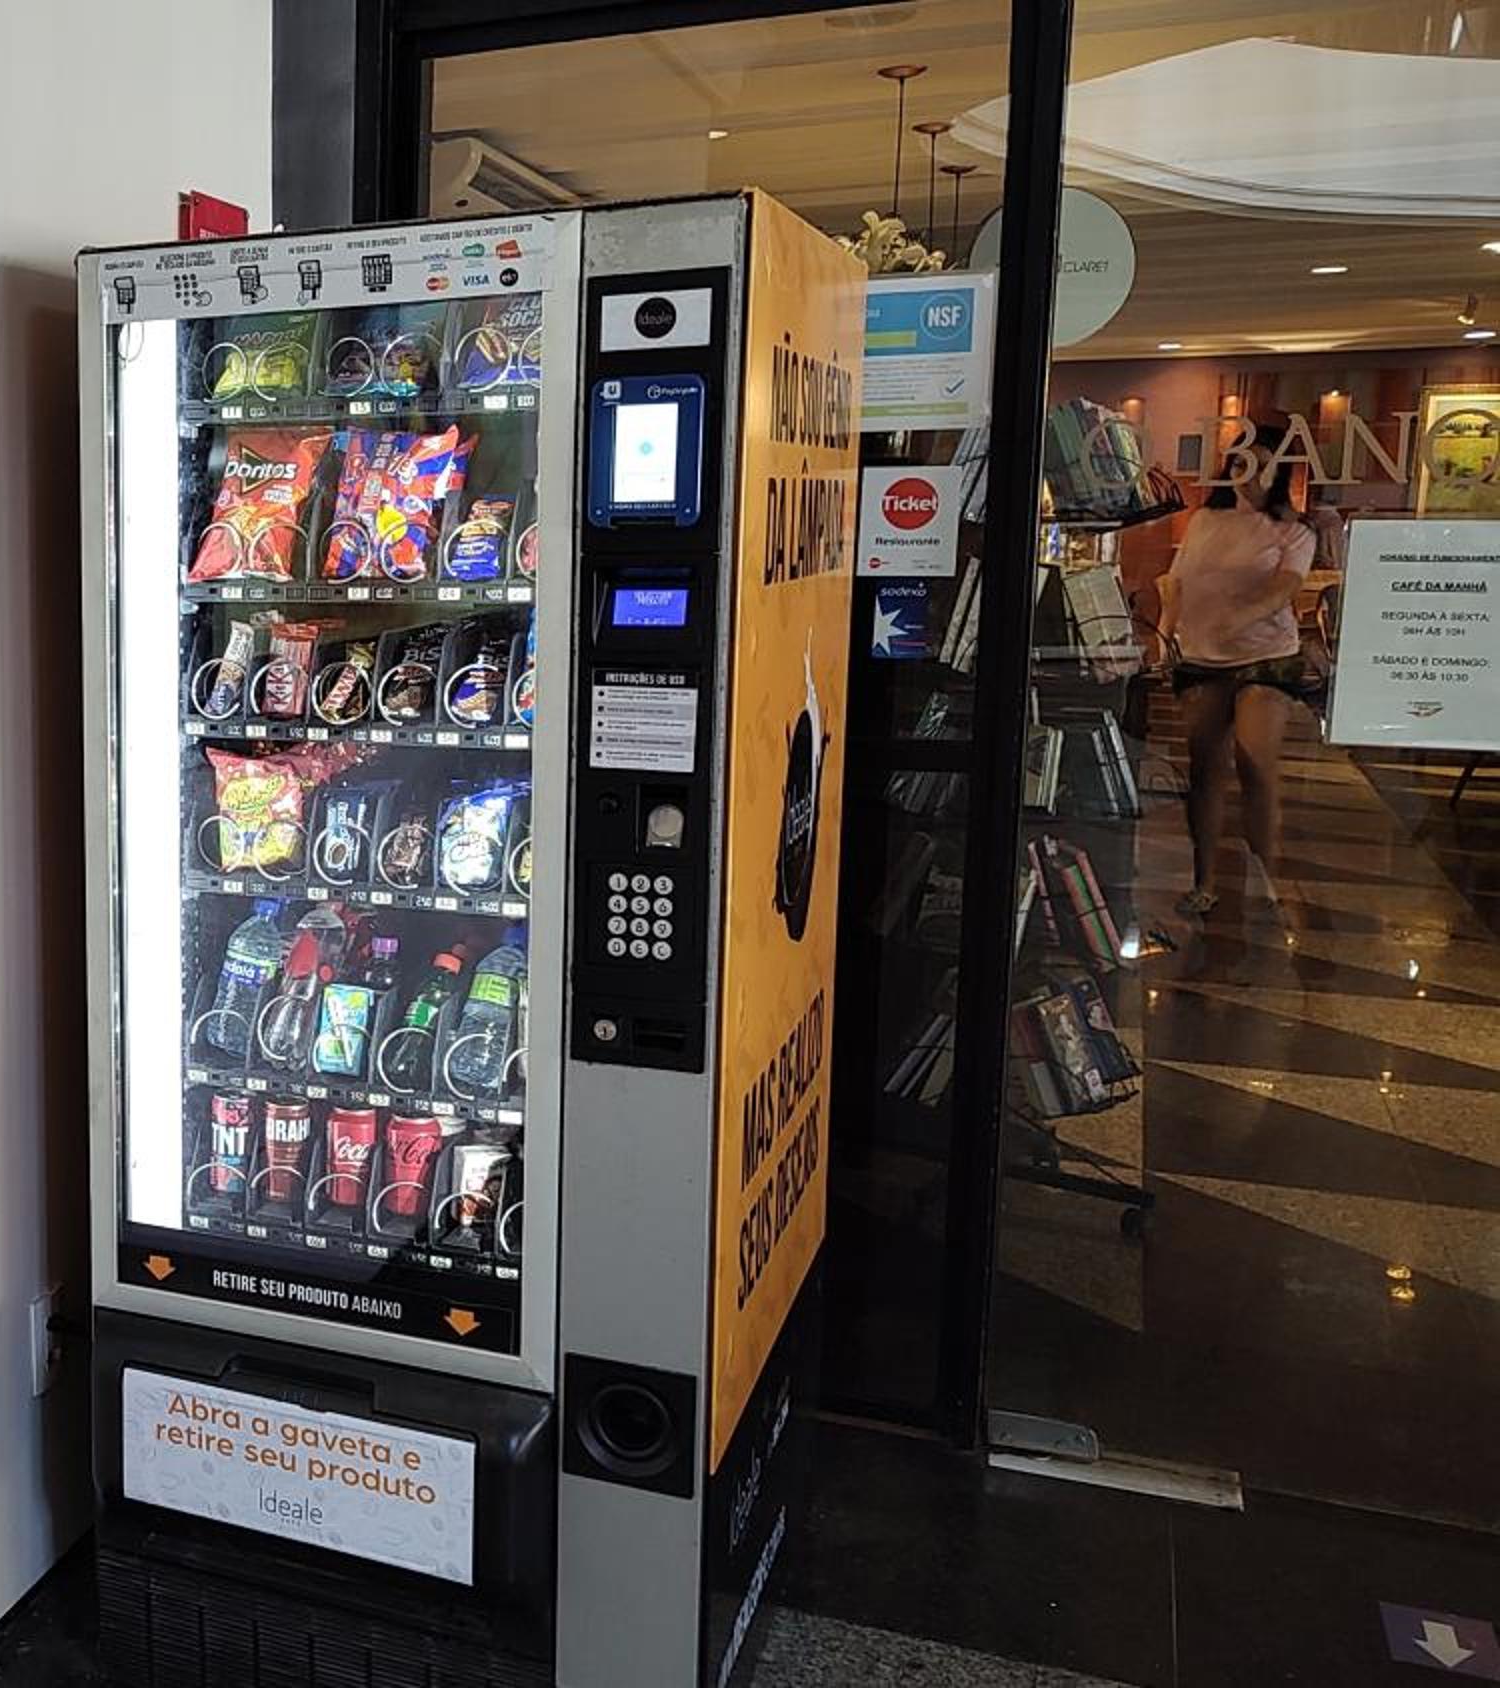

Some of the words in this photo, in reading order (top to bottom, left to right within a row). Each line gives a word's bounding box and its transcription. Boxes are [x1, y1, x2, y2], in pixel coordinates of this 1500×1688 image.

[463, 274, 490, 287] VISA
[927, 304, 963, 329] NSF
[769, 330, 799, 444] NÃO
[799, 355, 823, 447] SOU
[224, 460, 298, 479] Doritos
[883, 494, 938, 512] Ticket
[763, 477, 787, 586] DA
[880, 583, 927, 598] sodexo
[1391, 579, 1422, 592] CAFÉ
[1425, 581, 1442, 592] DA
[1381, 611, 1437, 622] SEGUNDA
[1439, 611, 1448, 621] A
[1372, 654, 1419, 666] SÁBADO
[1421, 656, 1429, 666] E
[615, 877, 621, 888] 1
[637, 878, 645, 890] 2
[659, 879, 667, 891] 3
[613, 899, 621, 910] 4
[637, 900, 644, 911] 5
[659, 902, 667, 913] 6
[614, 920, 621, 931] 7
[636, 921, 644, 933] 8
[659, 924, 666, 935] 9
[613, 941, 620, 952] 0
[740, 1056, 777, 1193] MAS
[211, 1122, 249, 1158] TNT
[736, 1176, 774, 1313] SEUS
[213, 1270, 257, 1293] RETIRE
[260, 1278, 285, 1298] SEU
[288, 1283, 349, 1310] PRODUTO
[351, 1293, 402, 1319] ABAIXO
[167, 1392, 242, 1431] Abra
[251, 1416, 270, 1437] a
[280, 1421, 392, 1464] gaveta
[402, 1449, 422, 1471] e
[155, 1419, 235, 1457] retire
[243, 1445, 297, 1473] seu
[307, 1454, 437, 1505] produto
[258, 1487, 324, 1526] Ideale
